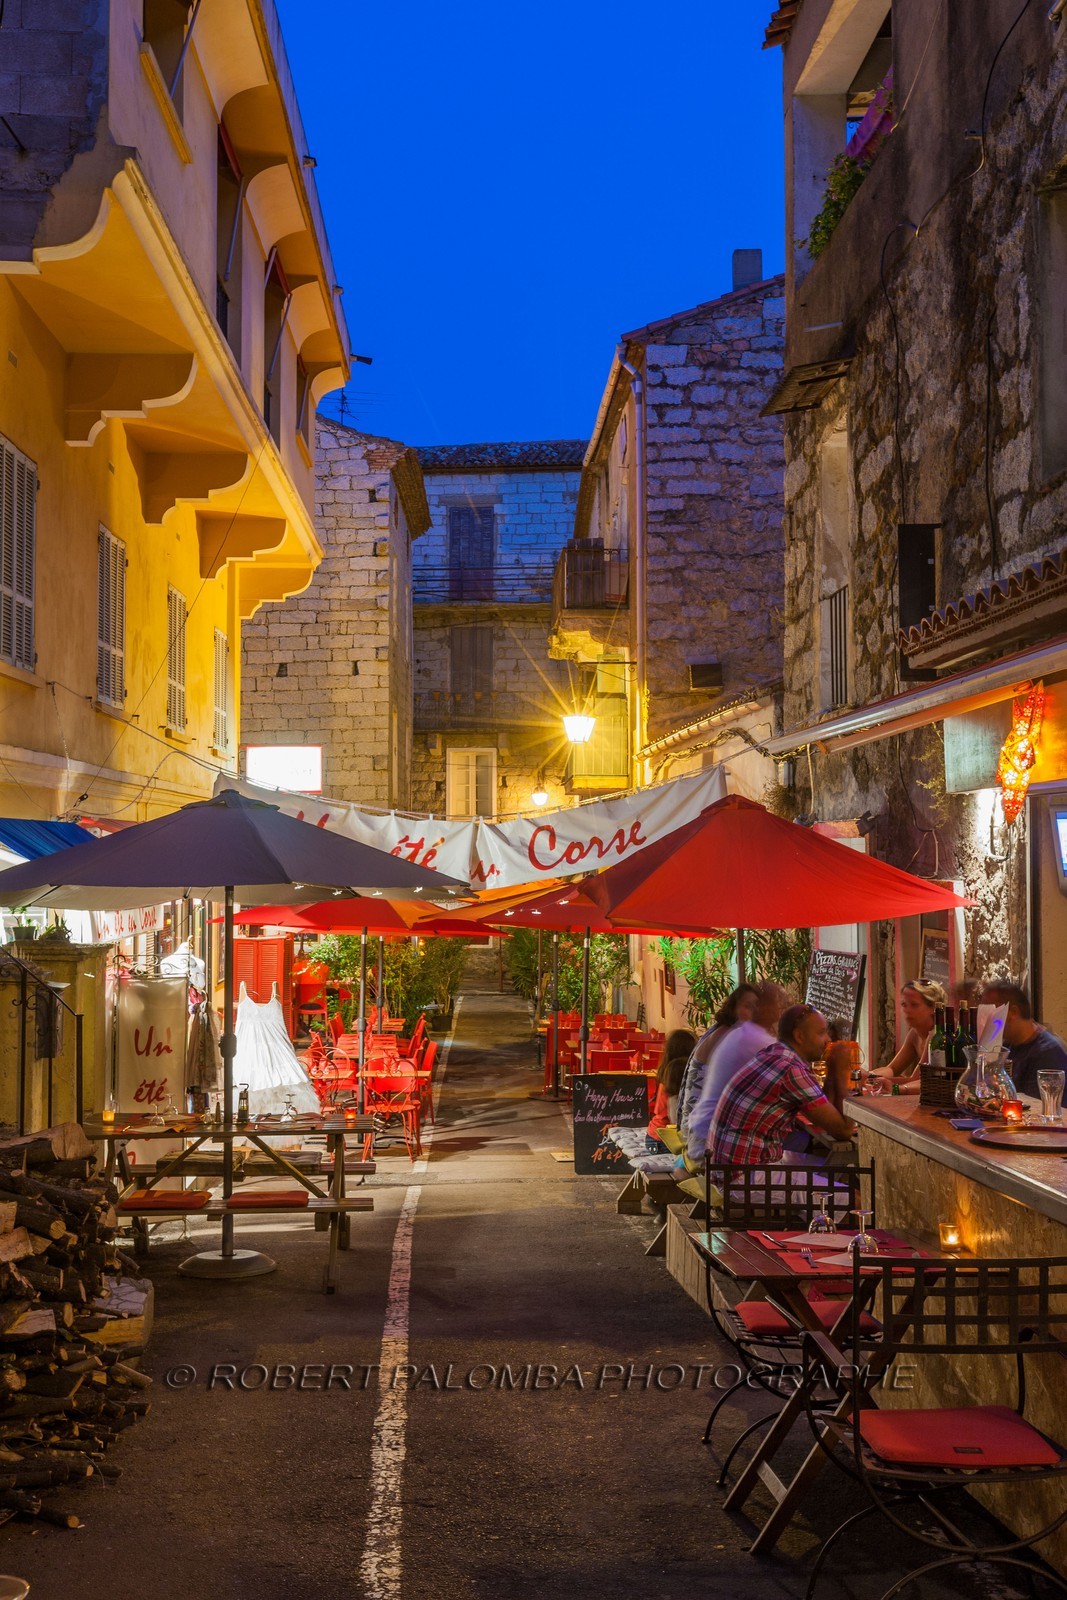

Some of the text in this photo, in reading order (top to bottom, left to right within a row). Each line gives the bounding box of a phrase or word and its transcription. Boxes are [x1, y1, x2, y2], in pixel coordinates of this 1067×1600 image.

[528, 820, 647, 871] Corse
[134, 1025, 173, 1057] Un
[133, 1078, 167, 1105] été
